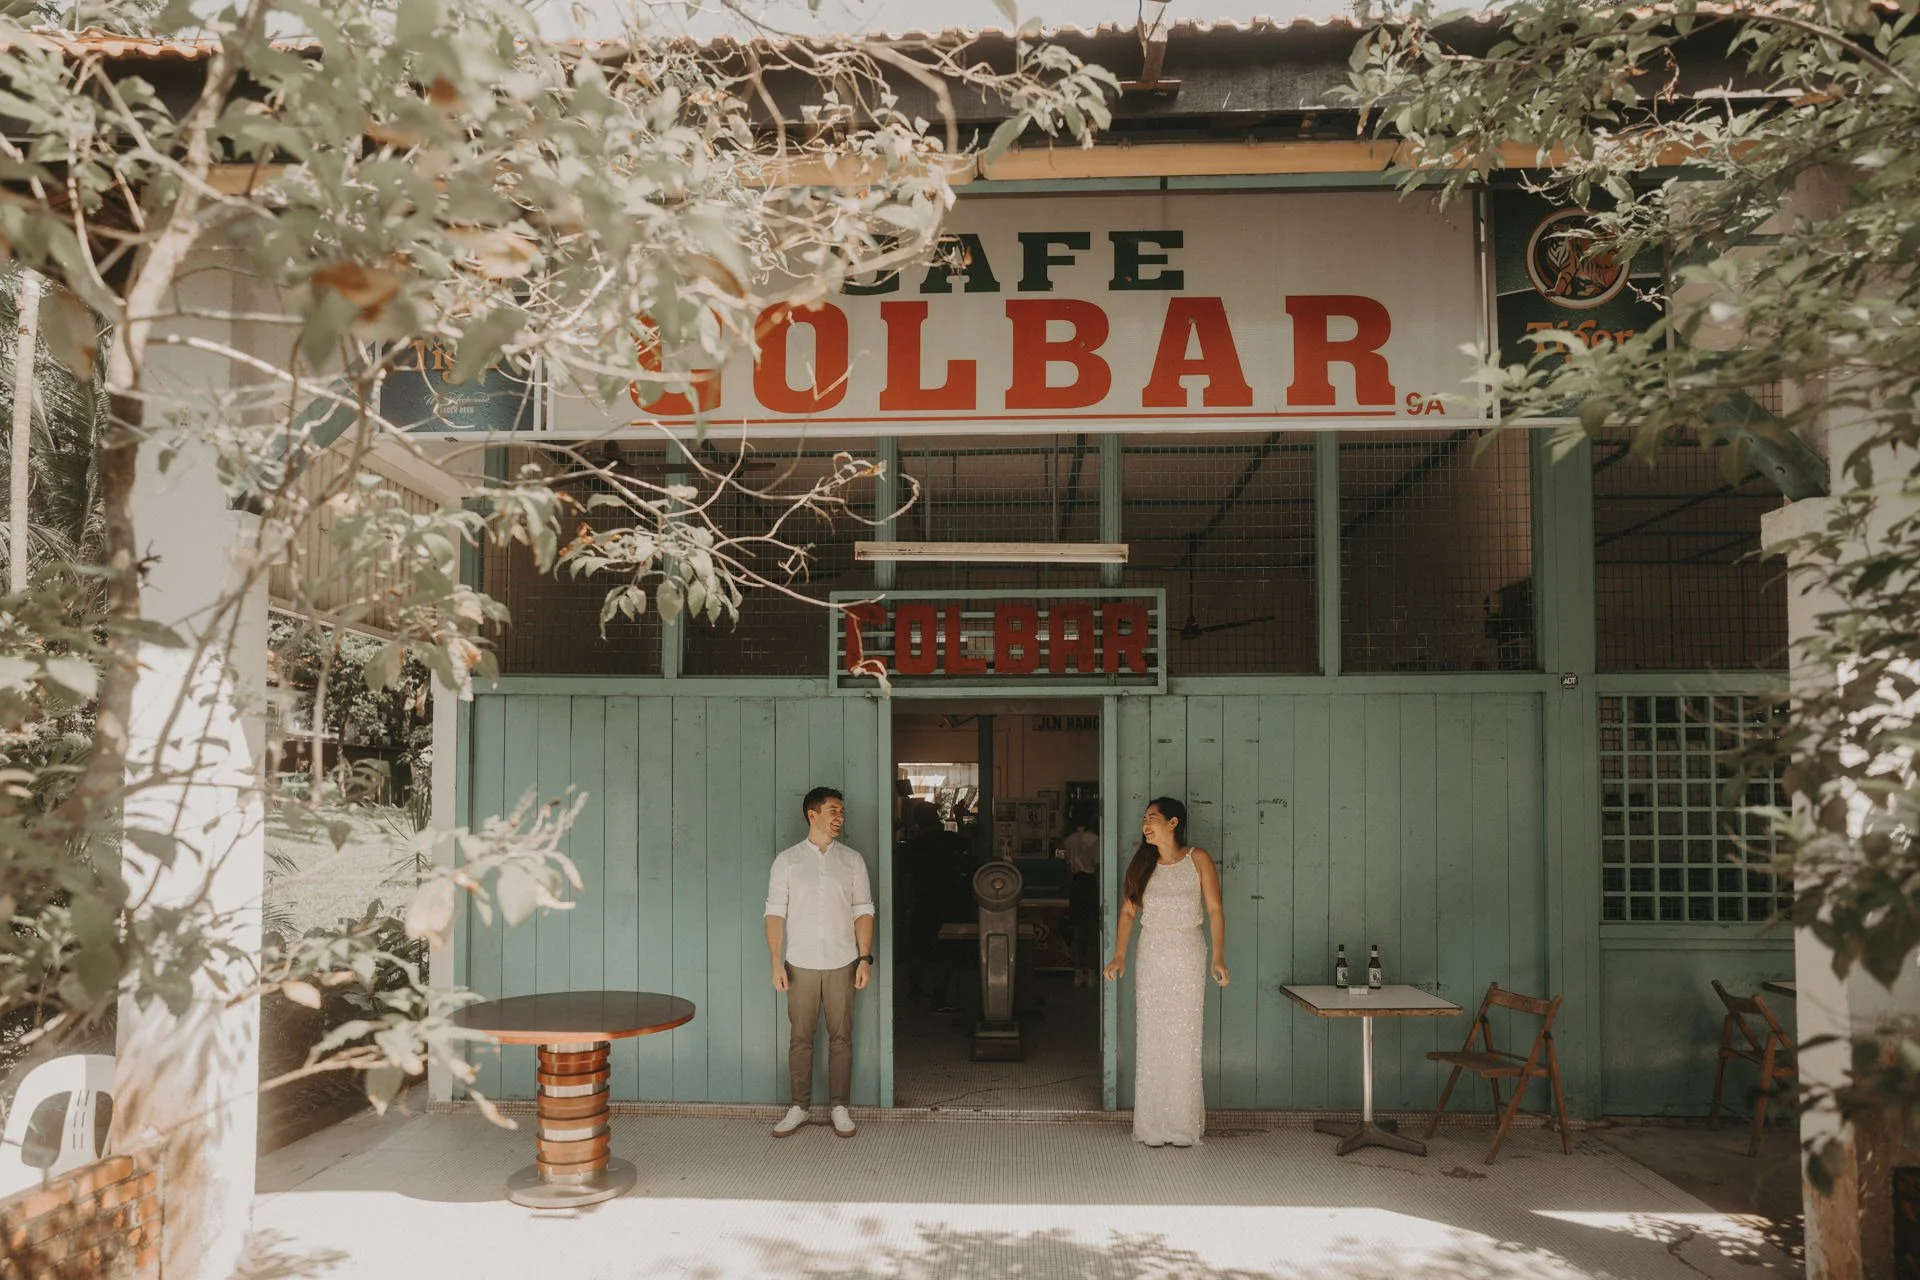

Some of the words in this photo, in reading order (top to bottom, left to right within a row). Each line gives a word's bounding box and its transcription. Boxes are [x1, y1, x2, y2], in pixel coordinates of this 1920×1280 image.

[845, 602, 1149, 675] COLBAR
[1563, 677, 1577, 685] ADT
[1037, 716, 1062, 730] JLN
